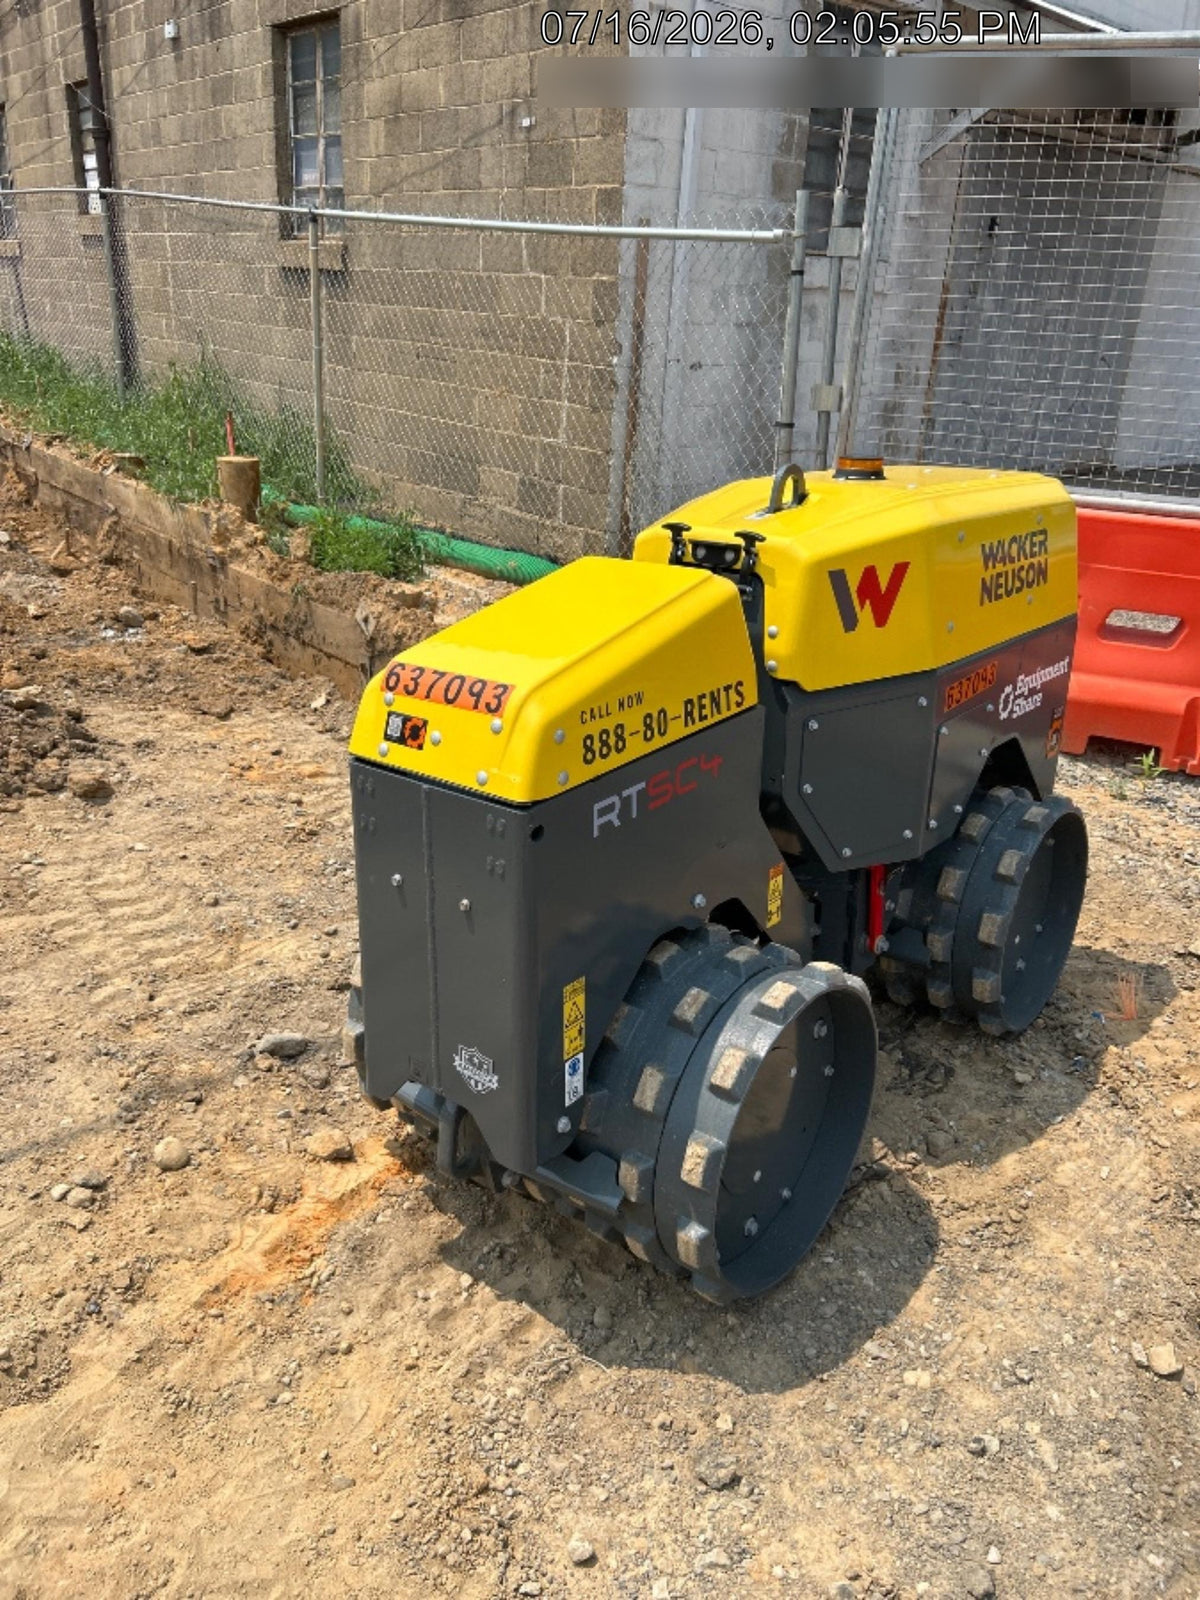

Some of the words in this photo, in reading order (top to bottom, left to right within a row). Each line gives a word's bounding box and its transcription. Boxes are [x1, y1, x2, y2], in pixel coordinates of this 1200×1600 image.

[980, 528, 1048, 572] WACKER
[979, 559, 1048, 607] NEUSON
[384, 662, 510, 714] 637093
[944, 662, 997, 708] 637093
[1014, 656, 1070, 696] Equipment
[580, 704, 613, 725] CALL
[617, 691, 645, 714] NOW
[582, 680, 746, 766] 888-80-RENTS
[1012, 692, 1043, 719] Share
[592, 754, 723, 838] RTSC4
